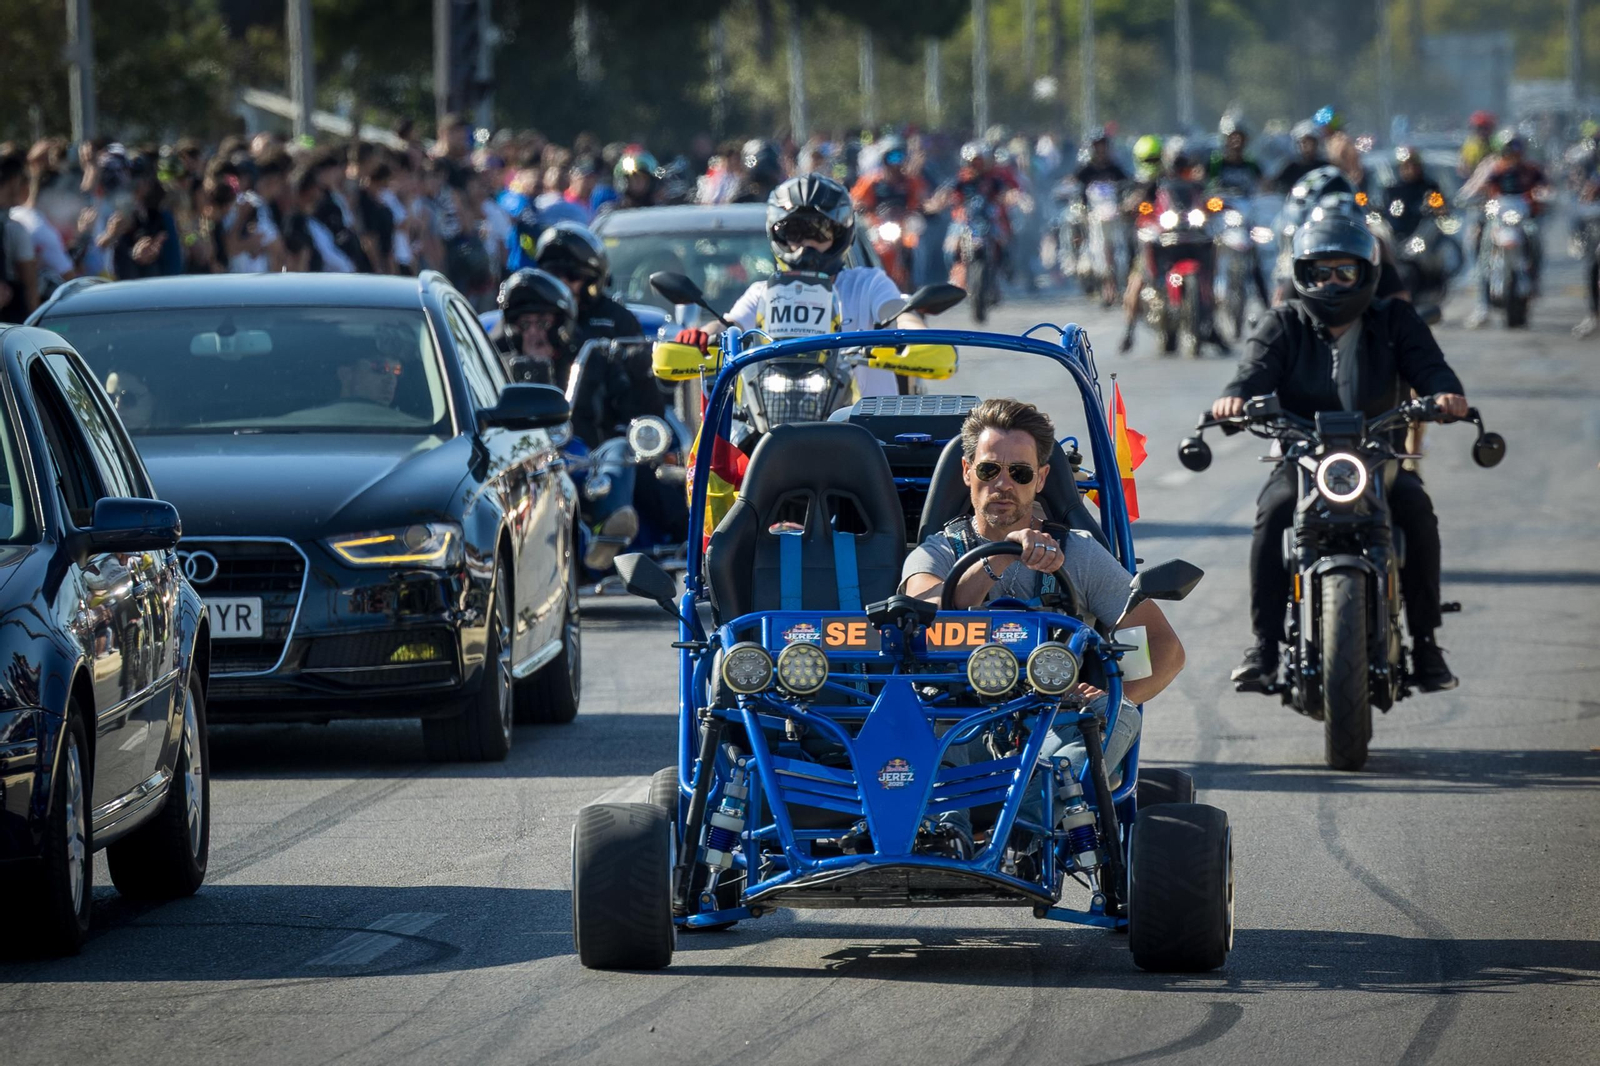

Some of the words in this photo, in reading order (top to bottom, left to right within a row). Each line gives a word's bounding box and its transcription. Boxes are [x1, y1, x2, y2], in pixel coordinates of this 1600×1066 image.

[770, 305, 826, 325] M07
[206, 604, 252, 632] YR
[825, 622, 868, 646] SE
[878, 773, 914, 782] JEREZ
